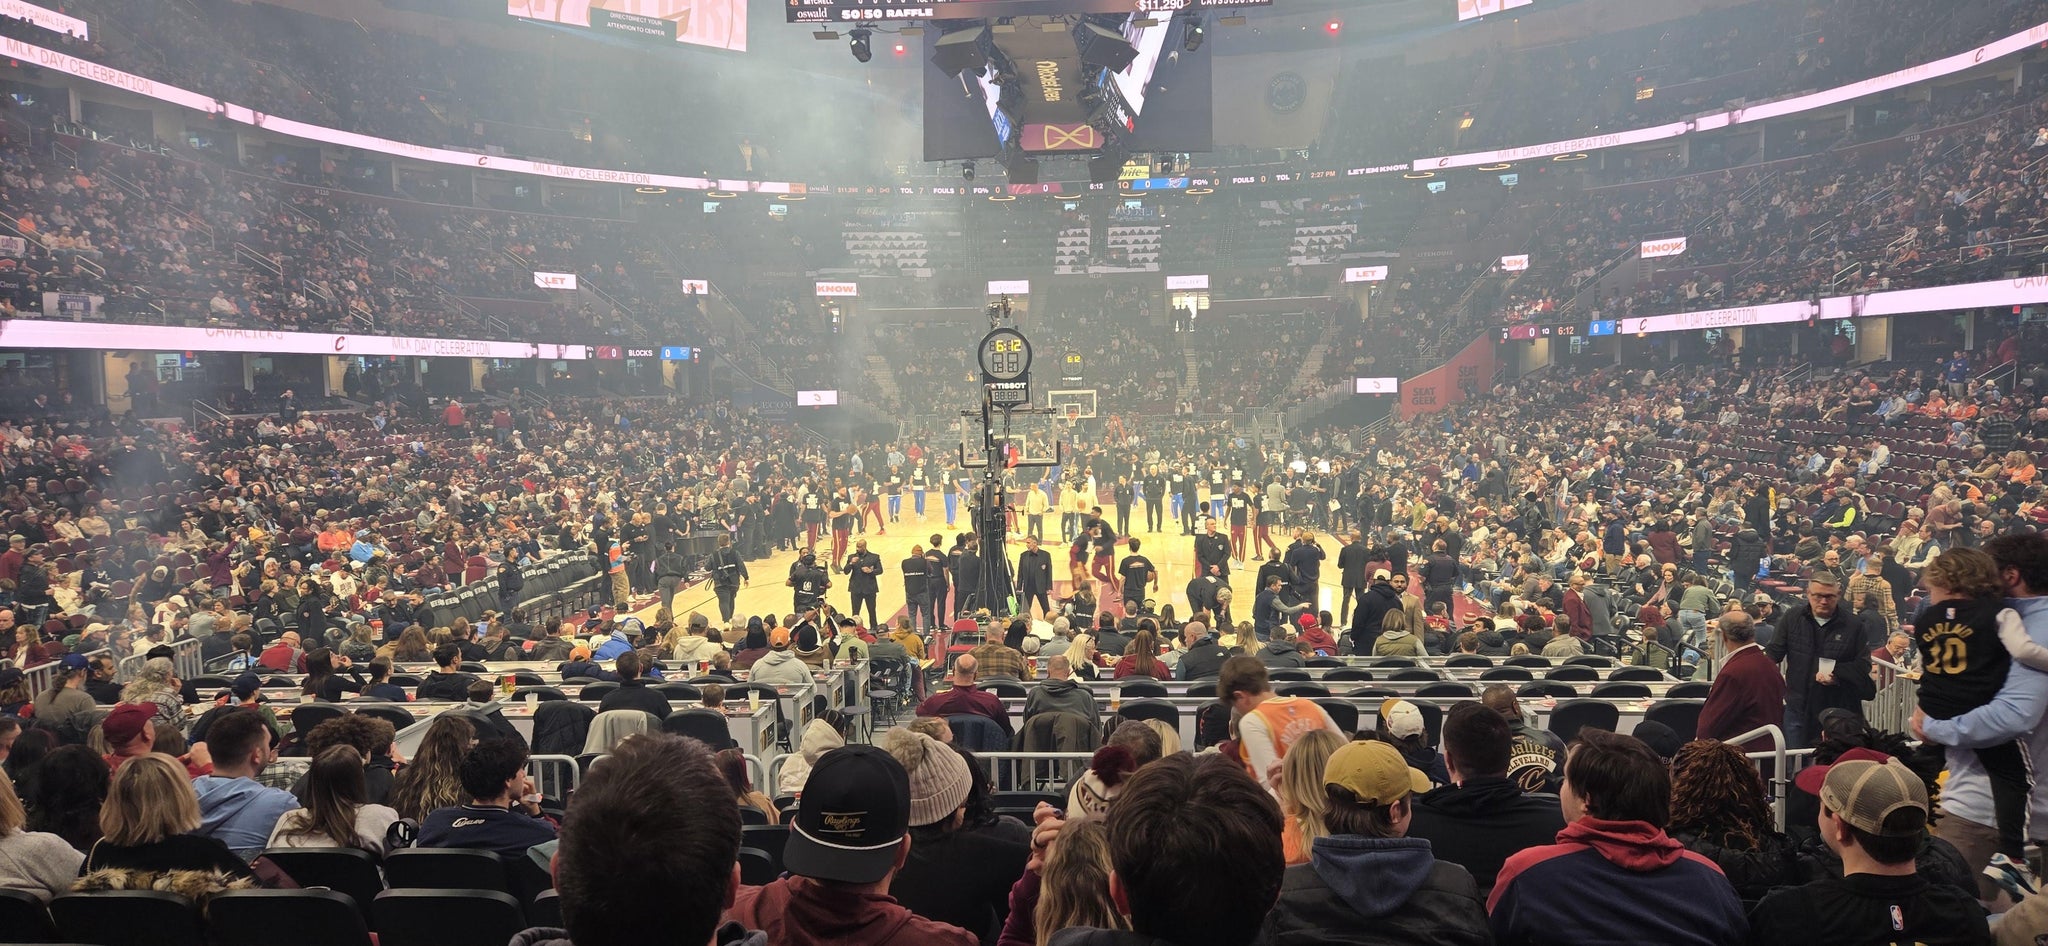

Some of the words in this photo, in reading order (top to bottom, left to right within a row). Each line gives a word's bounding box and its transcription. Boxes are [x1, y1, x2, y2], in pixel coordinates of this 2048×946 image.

[797, 7, 828, 18] oswald
[886, 8, 933, 18] RAFFLE
[647, 18, 663, 26] YOUR
[645, 28, 665, 36] CENTER
[6, 39, 35, 58] MLK
[40, 48, 66, 69] DAY
[69, 58, 153, 95] CELEBRATION
[1522, 146, 1542, 157] DAY
[1546, 134, 1621, 155] CELEBRATION
[556, 165, 575, 176] DAY
[578, 168, 650, 184] CELEBRATION
[1347, 168, 1365, 176] LET
[1379, 163, 1410, 172] KNOW.
[1042, 183, 1049, 193] 0
[1118, 181, 1130, 189] 1Q
[1144, 180, 1151, 188] 0
[1214, 178, 1220, 186] 0
[1232, 176, 1255, 184] FOULS
[1260, 174, 1266, 183] 0
[1276, 173, 1290, 181] TOL
[1310, 171, 1324, 179] 2:27
[1325, 170, 1336, 178] PM
[900, 186, 913, 194] TOL
[918, 186, 924, 195] 7
[933, 186, 955, 194] FOULS
[959, 187, 965, 195] 0
[1642, 241, 1685, 254] KNOW.
[1506, 259, 1523, 267] EM
[1356, 270, 1376, 278] LET
[545, 276, 566, 285] LET
[817, 285, 855, 293] KNOW.
[1705, 308, 1758, 326] CELEBRATION
[1528, 327, 1535, 337] 0
[1557, 326, 1574, 335] 6:12
[1593, 323, 1599, 333] 0
[415, 339, 432, 352] DAY
[434, 341, 491, 356] CELEBRATION
[996, 340, 1021, 352] 6:12
[611, 348, 617, 357] 0
[628, 349, 653, 357] BLOCKS
[664, 349, 670, 357] 0
[1458, 365, 1479, 377] SEAT
[997, 382, 1026, 390] TISSOT
[1412, 387, 1436, 396] SEAT
[1411, 396, 1437, 405] GEEK
[1926, 636, 1968, 675] 10
[824, 814, 861, 829] Rawlings
